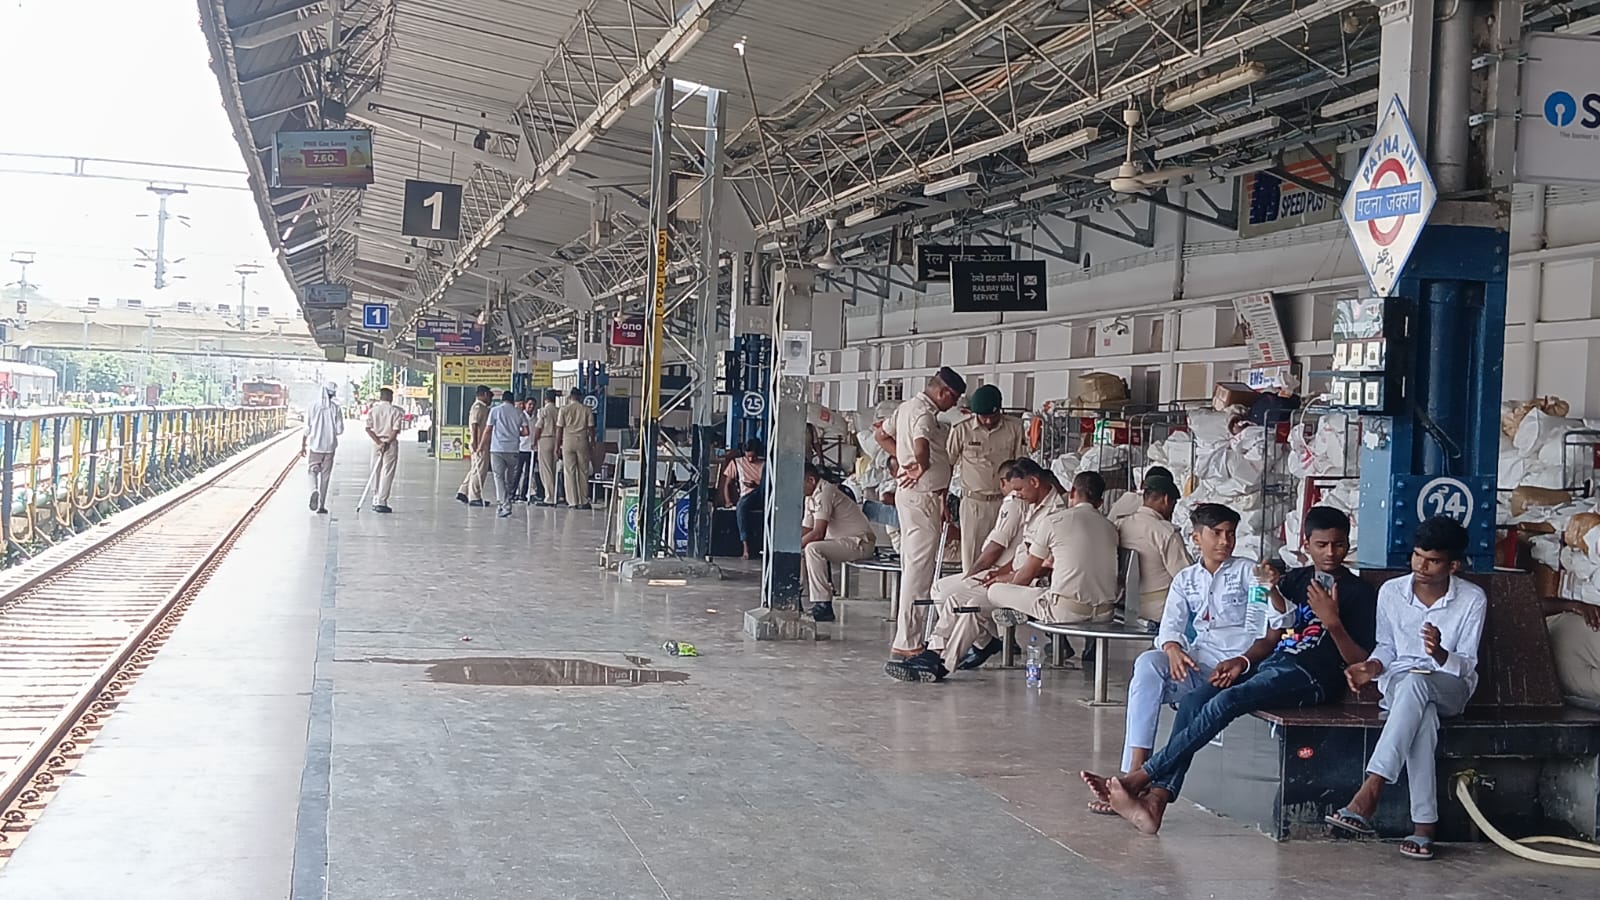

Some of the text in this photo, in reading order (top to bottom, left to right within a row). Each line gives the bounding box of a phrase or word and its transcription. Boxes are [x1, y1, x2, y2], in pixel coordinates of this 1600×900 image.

[1362, 134, 1399, 184] PATNA
[423, 191, 443, 231] 1
[1281, 191, 1307, 218] SPEED
[1356, 188, 1422, 216] पटना जंक्शन
[923, 249, 944, 265] रेल
[371, 308, 381, 324] 1
[362, 343, 369, 355] 1
[1249, 371, 1264, 386] EMS
[746, 398, 761, 410] 25
[1428, 491, 1467, 521] 24
